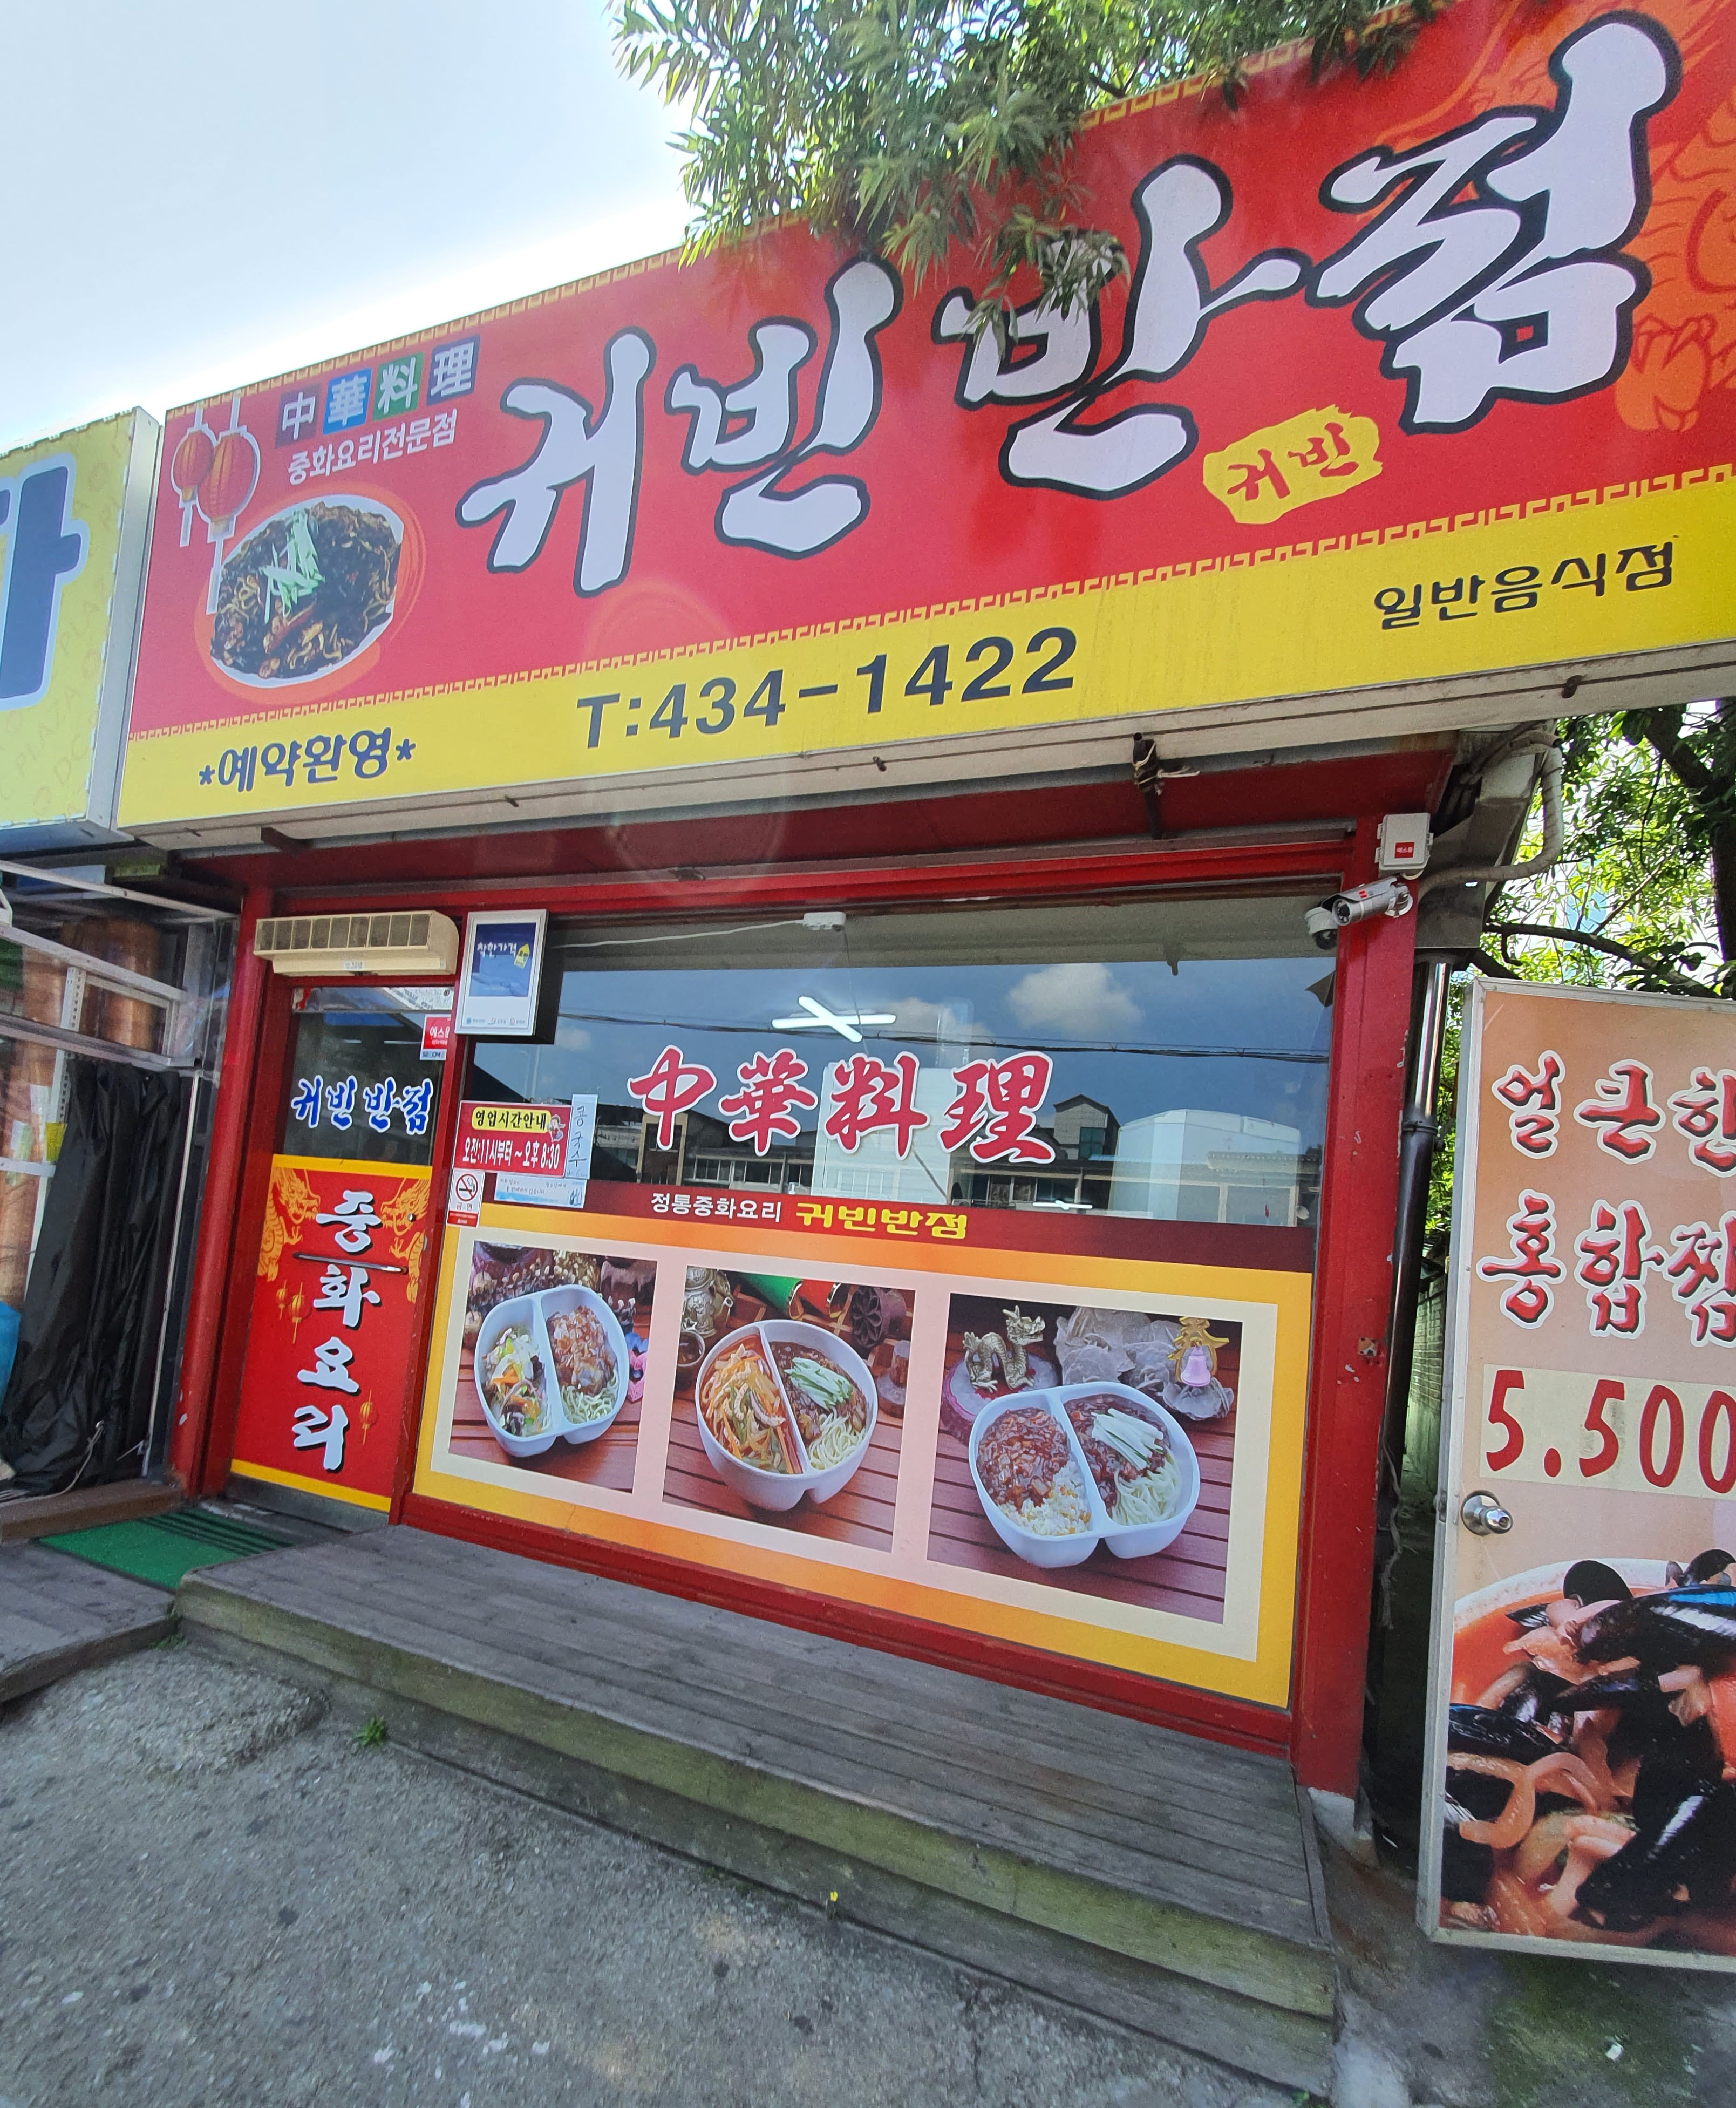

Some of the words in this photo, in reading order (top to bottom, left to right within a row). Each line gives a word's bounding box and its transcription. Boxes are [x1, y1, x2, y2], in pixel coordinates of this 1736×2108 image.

[456, 10, 1683, 597] 귀빈반점
[282, 341, 474, 440] 中華料理
[288, 409, 457, 485] 중화요리전문점
[1226, 421, 1360, 502] 귀빈
[1374, 541, 1676, 631] 일반음식점
[576, 626, 1078, 749] T:434-1422
[291, 1075, 433, 1135] 귀빈반점
[475, 1110, 547, 1131] 영업시간안내
[568, 1105, 588, 1168] 콩국수
[627, 1044, 1057, 1164] 中華料理
[1493, 1049, 1736, 1178] 얼큰한
[522, 1140, 540, 1169] 오후
[541, 1143, 560, 1170] 8:30
[651, 1193, 782, 1223] 정통중화요리
[795, 1202, 969, 1240] 귀빈반점
[292, 1189, 382, 1472] 중화요리
[1486, 1369, 1736, 1494] 5.500
